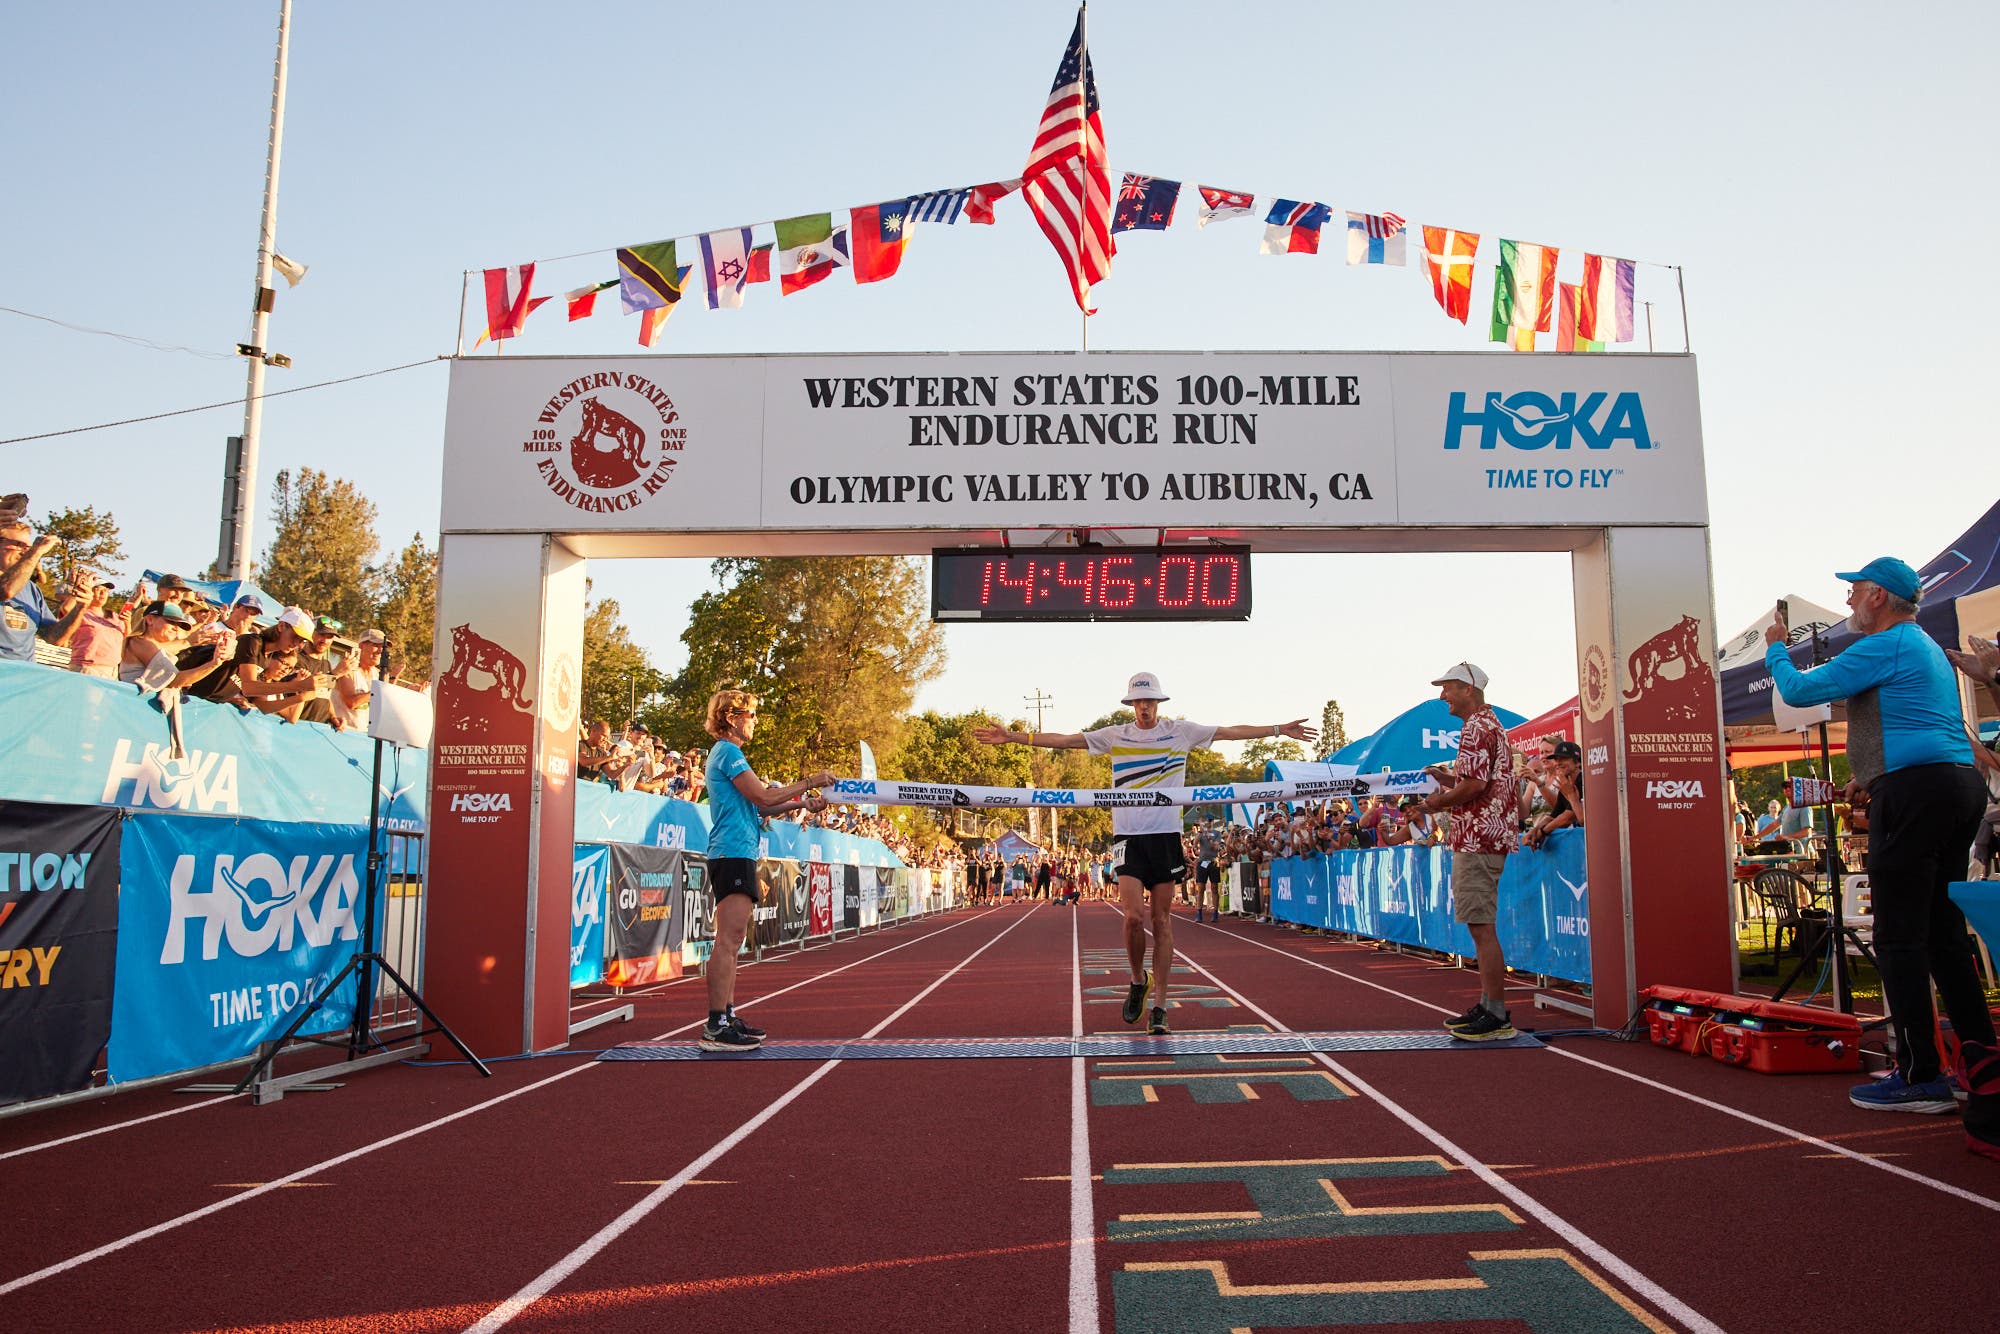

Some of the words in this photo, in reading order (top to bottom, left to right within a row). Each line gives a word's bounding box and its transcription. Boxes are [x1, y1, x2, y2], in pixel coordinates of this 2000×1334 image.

[538, 371, 624, 424] WESTERN
[624, 374, 680, 424] STATES
[803, 375, 999, 408] WESTERN
[1013, 373, 1159, 406] STATES
[1176, 374, 1360, 406] 100-MILE
[532, 429, 556, 440] 100
[660, 428, 687, 439] ONE
[909, 413, 1158, 446] ENDURANCE
[1172, 413, 1258, 445] RUN
[522, 441, 562, 452] MILES
[661, 440, 686, 451] DAY
[537, 457, 642, 513] ENDURANCE
[641, 455, 678, 497] RUN
[1485, 469, 1538, 489] TIME
[1543, 469, 1574, 489] TO
[790, 474, 953, 505] OLYMPIC
[963, 473, 1092, 502] VALLEY
[1101, 471, 1150, 501] TO
[1160, 472, 1319, 509] AUBURN,
[1328, 472, 1374, 500] CA
[1629, 733, 1677, 743] WESTERN
[1678, 733, 1713, 743] STATES
[439, 745, 490, 755] WESTERN
[490, 744, 527, 754] STATES
[1587, 745, 1609, 767] HOKA
[1630, 743, 1691, 753] ENDURANCE
[1692, 743, 1713, 753] RUN
[439, 755, 503, 765] ENDURANCE
[503, 755, 527, 764] RUN
[101, 738, 240, 813] HOKA
[1384, 771, 1428, 787] HOKA
[833, 779, 877, 795] HOKA
[898, 786, 929, 794] WESTERN
[929, 787, 953, 795] STATES
[1295, 781, 1328, 790] WESTERN
[1329, 779, 1354, 788] STATES
[1645, 780, 1704, 798] HOKA
[898, 793, 937, 801] ENDURANCE
[937, 793, 952, 801] RUN
[983, 796, 1019, 805] 2021
[1031, 790, 1076, 804] HOKA
[1094, 792, 1127, 800] WESTERN
[1128, 791, 1154, 799] STATES
[1191, 786, 1235, 801] HOKA
[1249, 790, 1284, 800] 2021
[450, 794, 512, 812] HOKA
[656, 822, 686, 850] HOKA
[619, 888, 637, 910] GU
[160, 853, 360, 965] HOKA
[1556, 915, 1576, 935] TIME
[1576, 917, 1589, 937] TO
[209, 985, 263, 1028] TIME
[267, 980, 300, 1018] TO
